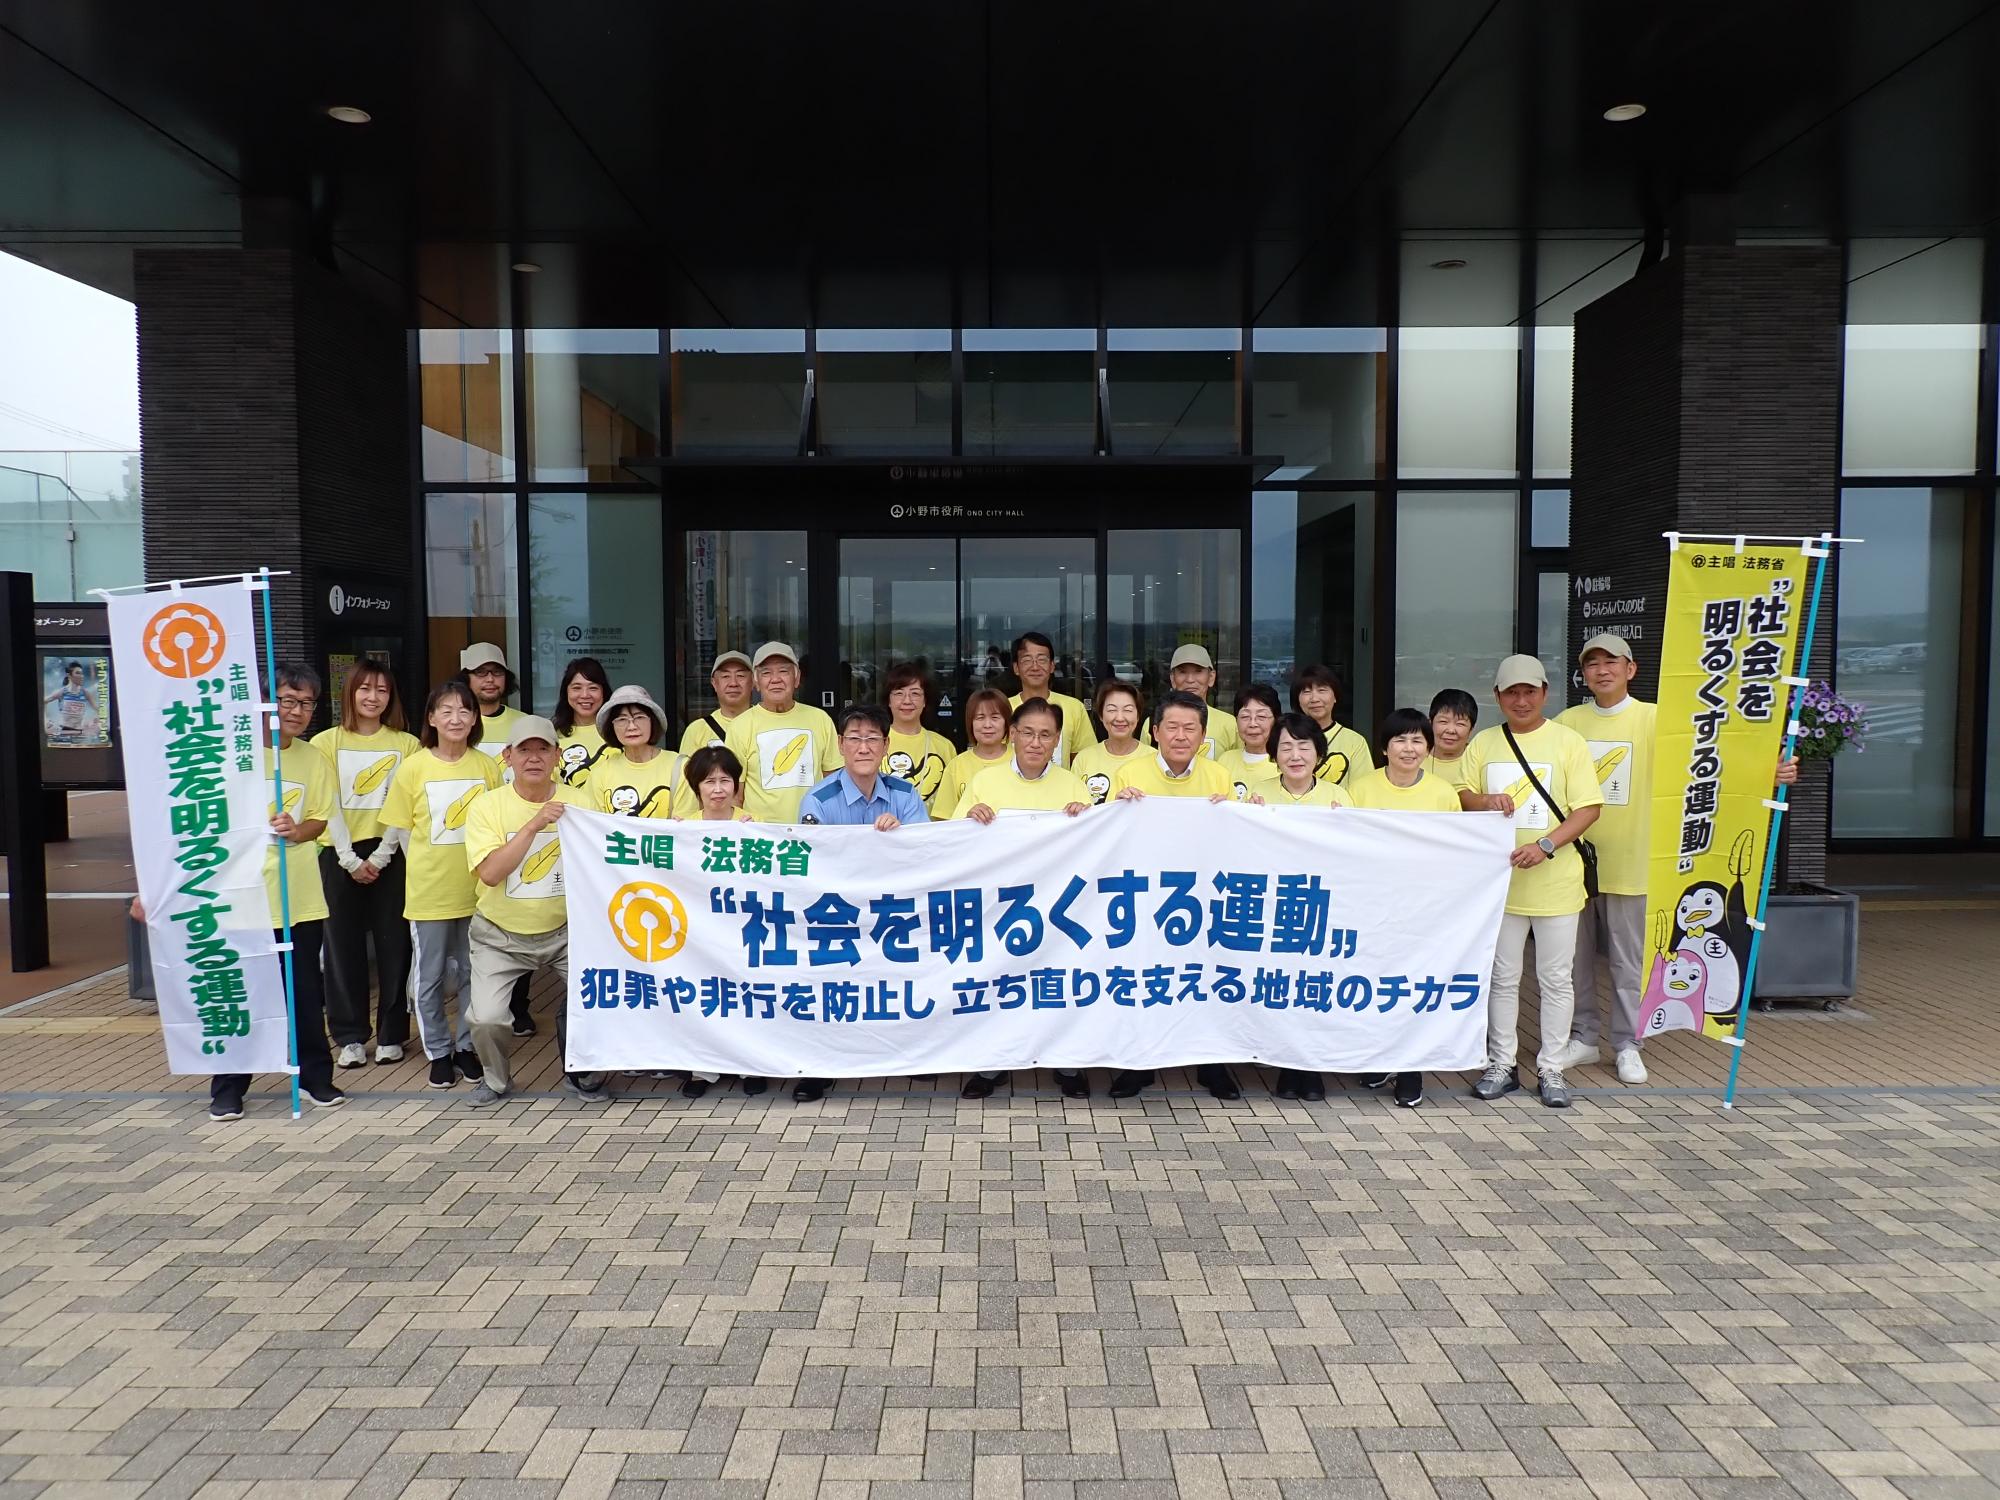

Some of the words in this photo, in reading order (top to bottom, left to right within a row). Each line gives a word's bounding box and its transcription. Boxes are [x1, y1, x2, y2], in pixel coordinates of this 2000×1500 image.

[905, 505, 963, 517] 小野市役所
[1707, 555, 1736, 569] 主唱
[1742, 556, 1785, 571] 法務省
[345, 595, 391, 610] インフォメーション
[1591, 596, 1646, 616] らんらんバスのりば
[34, 617, 84, 627] ォメーション
[228, 663, 249, 701] 主唱
[233, 714, 254, 773] 法務省
[604, 830, 674, 871] 主唱
[700, 836, 813, 877] 法務省
[580, 967, 935, 1023] 犯罪や非行を防止し
[952, 962, 1481, 1015] 立ち直りを支える地域のチカラ
